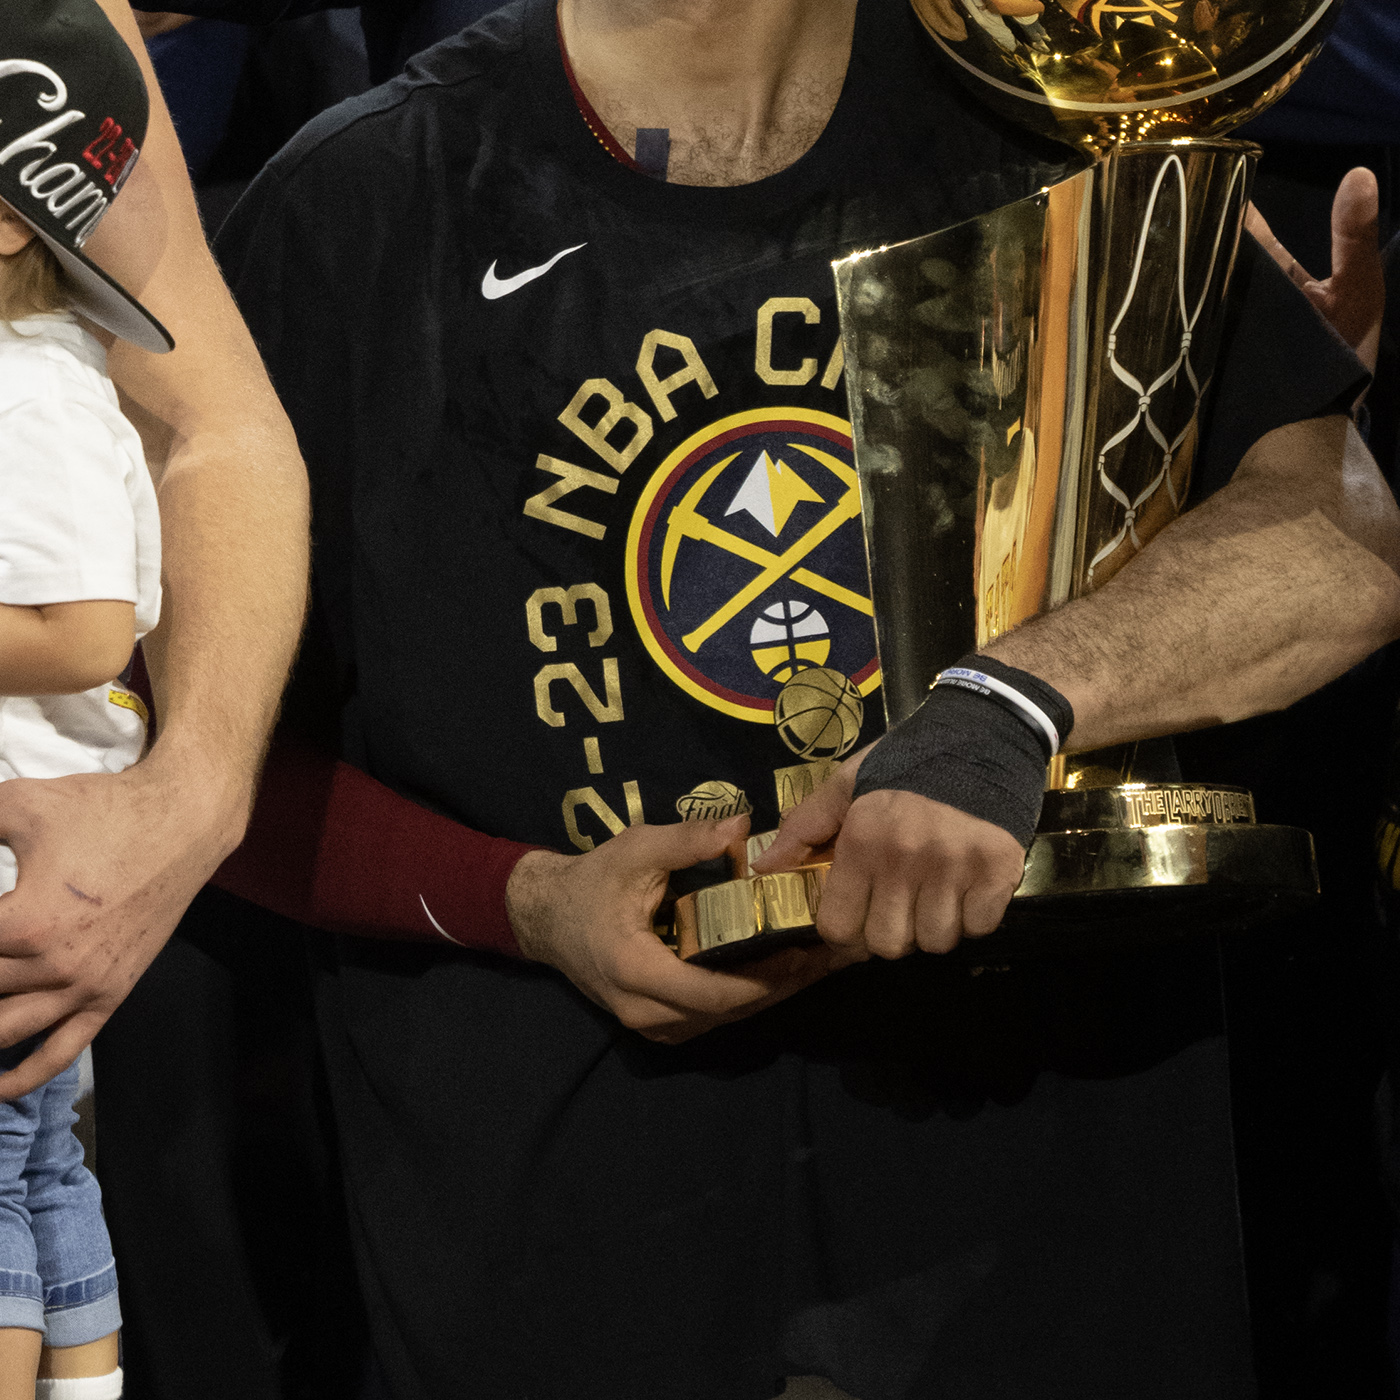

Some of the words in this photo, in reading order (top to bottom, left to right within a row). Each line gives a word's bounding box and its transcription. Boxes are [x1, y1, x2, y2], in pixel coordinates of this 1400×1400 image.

[522, 327, 720, 541] NBA
[1120, 790, 1166, 828] THE
[1164, 789, 1212, 825] LARRY
